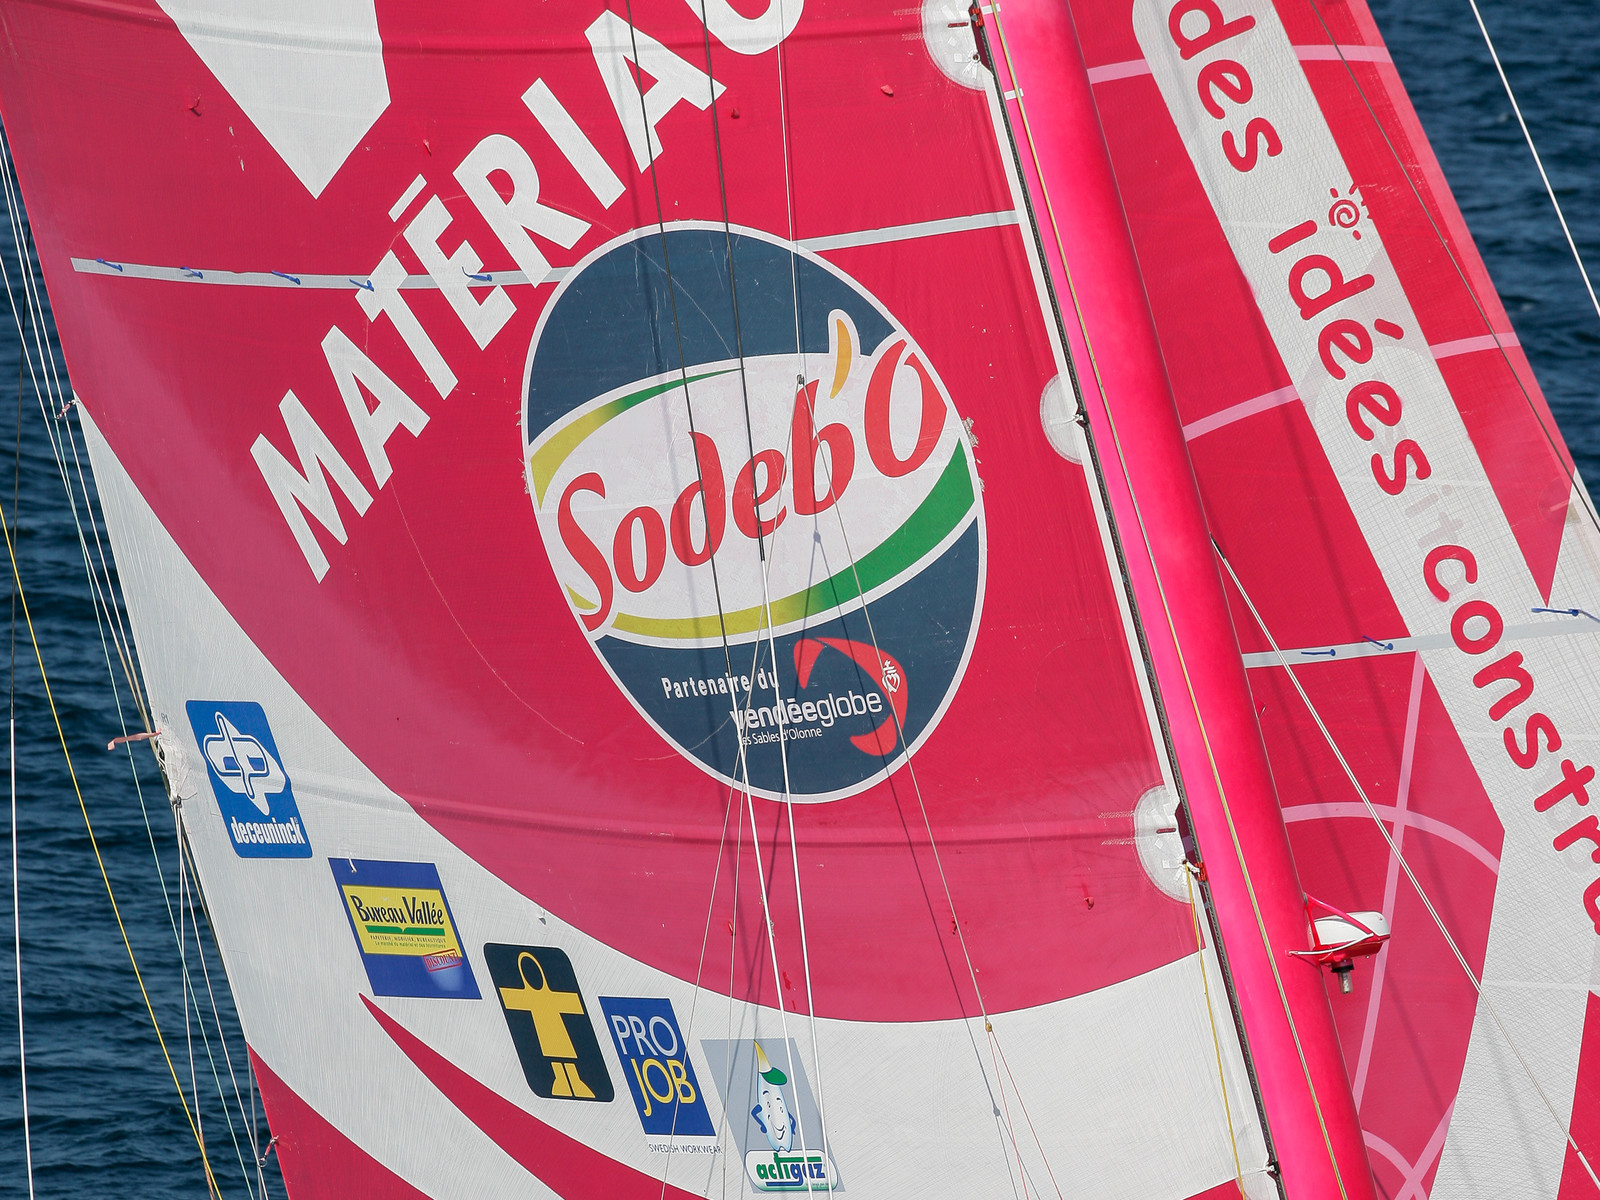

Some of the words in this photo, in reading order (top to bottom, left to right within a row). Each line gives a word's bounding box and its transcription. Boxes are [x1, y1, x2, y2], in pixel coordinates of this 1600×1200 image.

[1168, 0, 1284, 174] des
[1267, 190, 1432, 497] idées
[661, 672, 750, 699] Partenaire
[757, 667, 780, 690] du
[752, 729, 780, 745] Sables
[231, 816, 306, 845] deceuninck
[350, 895, 407, 923] Bureau
[402, 896, 444, 925] Vallée
[610, 1014, 678, 1057] PRO
[631, 1058, 696, 1117] JOB
[649, 1143, 679, 1154] SWEDISH
